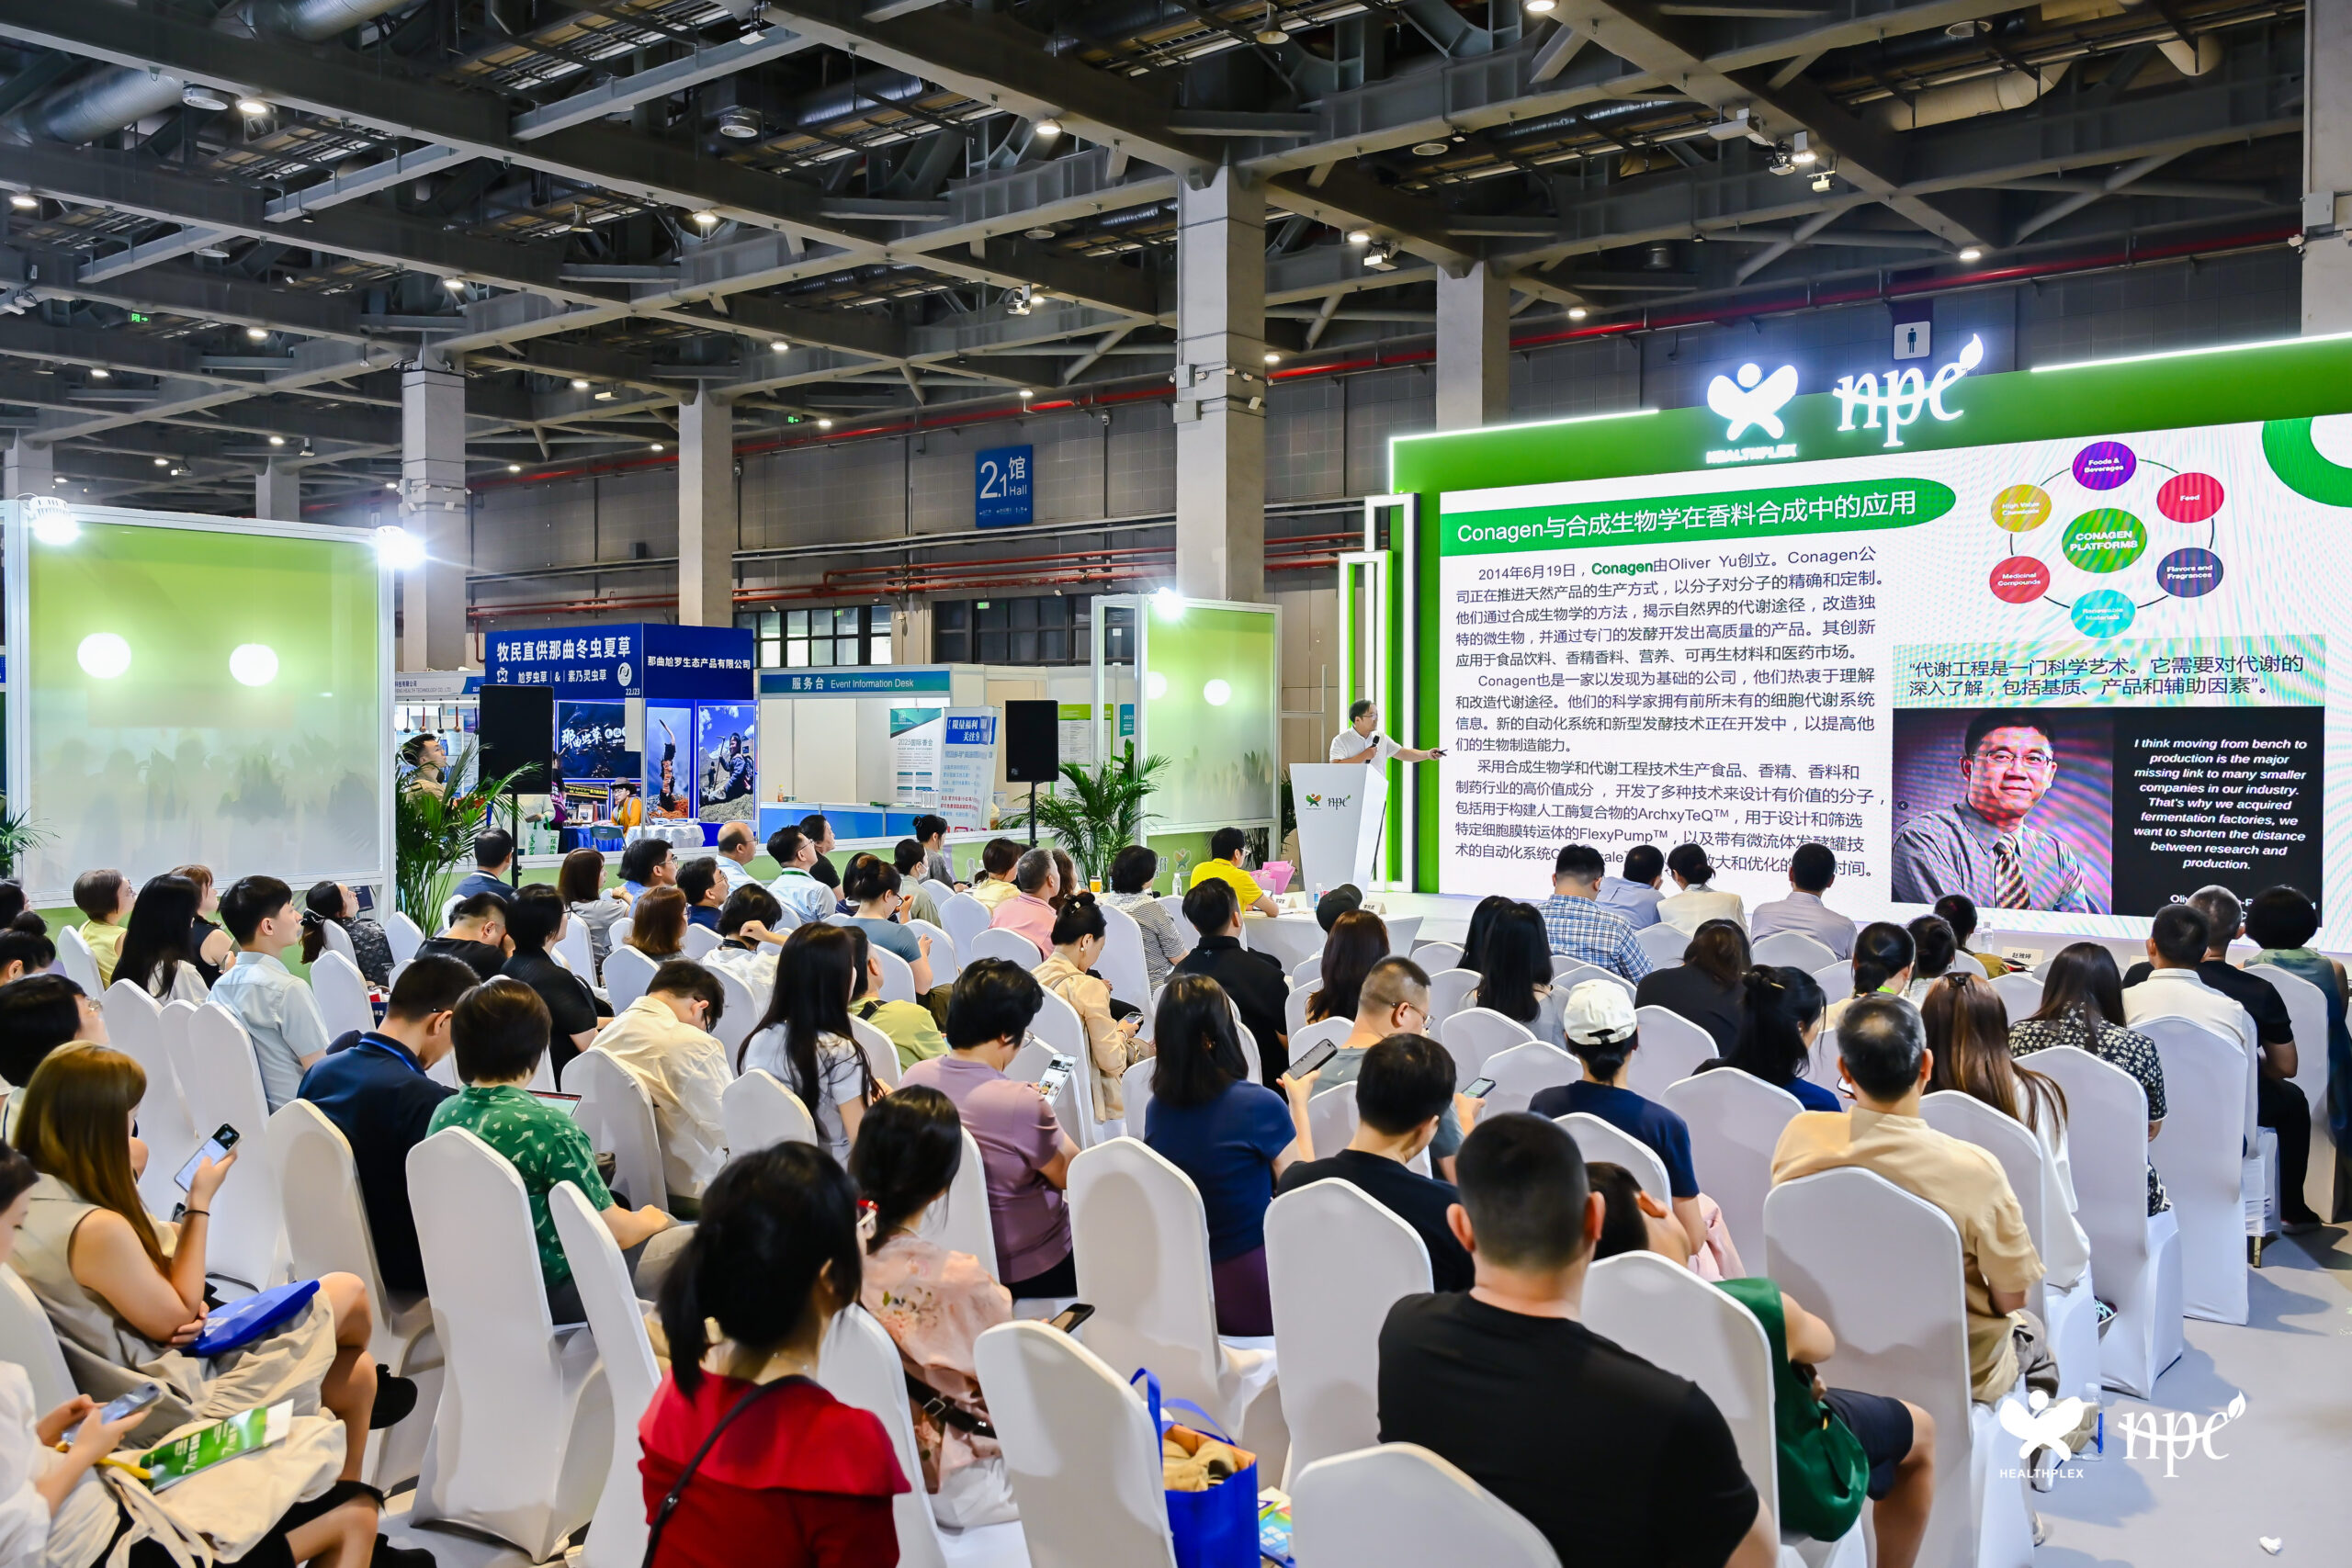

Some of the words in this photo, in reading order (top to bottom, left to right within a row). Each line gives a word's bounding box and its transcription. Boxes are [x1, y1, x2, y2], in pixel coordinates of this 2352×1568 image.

[2084, 465, 2124, 473] Beverages
[980, 460, 1006, 499] 2.1
[1009, 456, 1025, 479] 馆
[1010, 485, 1027, 496] Hall
[1457, 490, 1917, 543] Conagen与合成生物学在香料合成中的应用
[2075, 530, 2132, 541] CONAGEN
[2070, 540, 2138, 552] PLATFORMS
[1456, 570, 1883, 604] 司正在推进天然产品的生产方式，以分子对分子的精确和定制。
[1455, 593, 1876, 625] 他们通过合成生物学的方法，揭示自然界的代谢途径，改造独
[497, 636, 631, 662] 牧民直供那曲冬虫夏草
[554, 671, 561, 682] &
[791, 676, 825, 691] 服务台
[831, 679, 851, 689] Event
[853, 678, 893, 689] Information
[895, 678, 915, 688] Desk
[1478, 667, 1875, 689] Conagen也是一家以发现为基础的公司，他们热衷于理解
[1455, 691, 1875, 710] 和改造代谢途径。他们的科学家拥有前所未有的细胞代谢系统
[1455, 715, 1875, 732] 信息。新的自动化系统和新型发酵技术正在开发中，以提高他
[1455, 737, 1571, 753] 们的生物制造能力。
[2134, 739, 2139, 748] I
[2142, 739, 2170, 748] think
[2173, 739, 2218, 750] moving
[2221, 739, 2249, 749] from
[2252, 739, 2291, 749] bench
[2295, 740, 2307, 749] to
[2149, 754, 2213, 764] production
[2216, 754, 2227, 763] is
[2230, 754, 2250, 763] the
[2254, 755, 2290, 766] major
[2134, 768, 2180, 780] missing
[2183, 769, 2204, 778] link
[2207, 770, 2219, 778] to
[2222, 772, 2257, 781] many
[2260, 770, 2306, 779] smaller
[2140, 784, 2205, 794] companies
[2208, 784, 2219, 793] in
[2246, 784, 2299, 796] industry.
[2149, 797, 2184, 807] That's
[2188, 798, 2212, 810] why
[2236, 800, 2292, 811] acquired
[2141, 812, 2215, 823] fermentation
[2219, 814, 2275, 826] factories,
[2279, 818, 2298, 826] we
[2134, 828, 2163, 836] want
[2165, 829, 2177, 837] to
[2180, 828, 2226, 838] shorten
[2229, 829, 2249, 839] the
[2252, 830, 2305, 841] distance
[2151, 841, 2201, 852] between
[2205, 845, 2259, 854] research
[2262, 847, 2288, 855] and
[2183, 859, 2250, 869] production.
